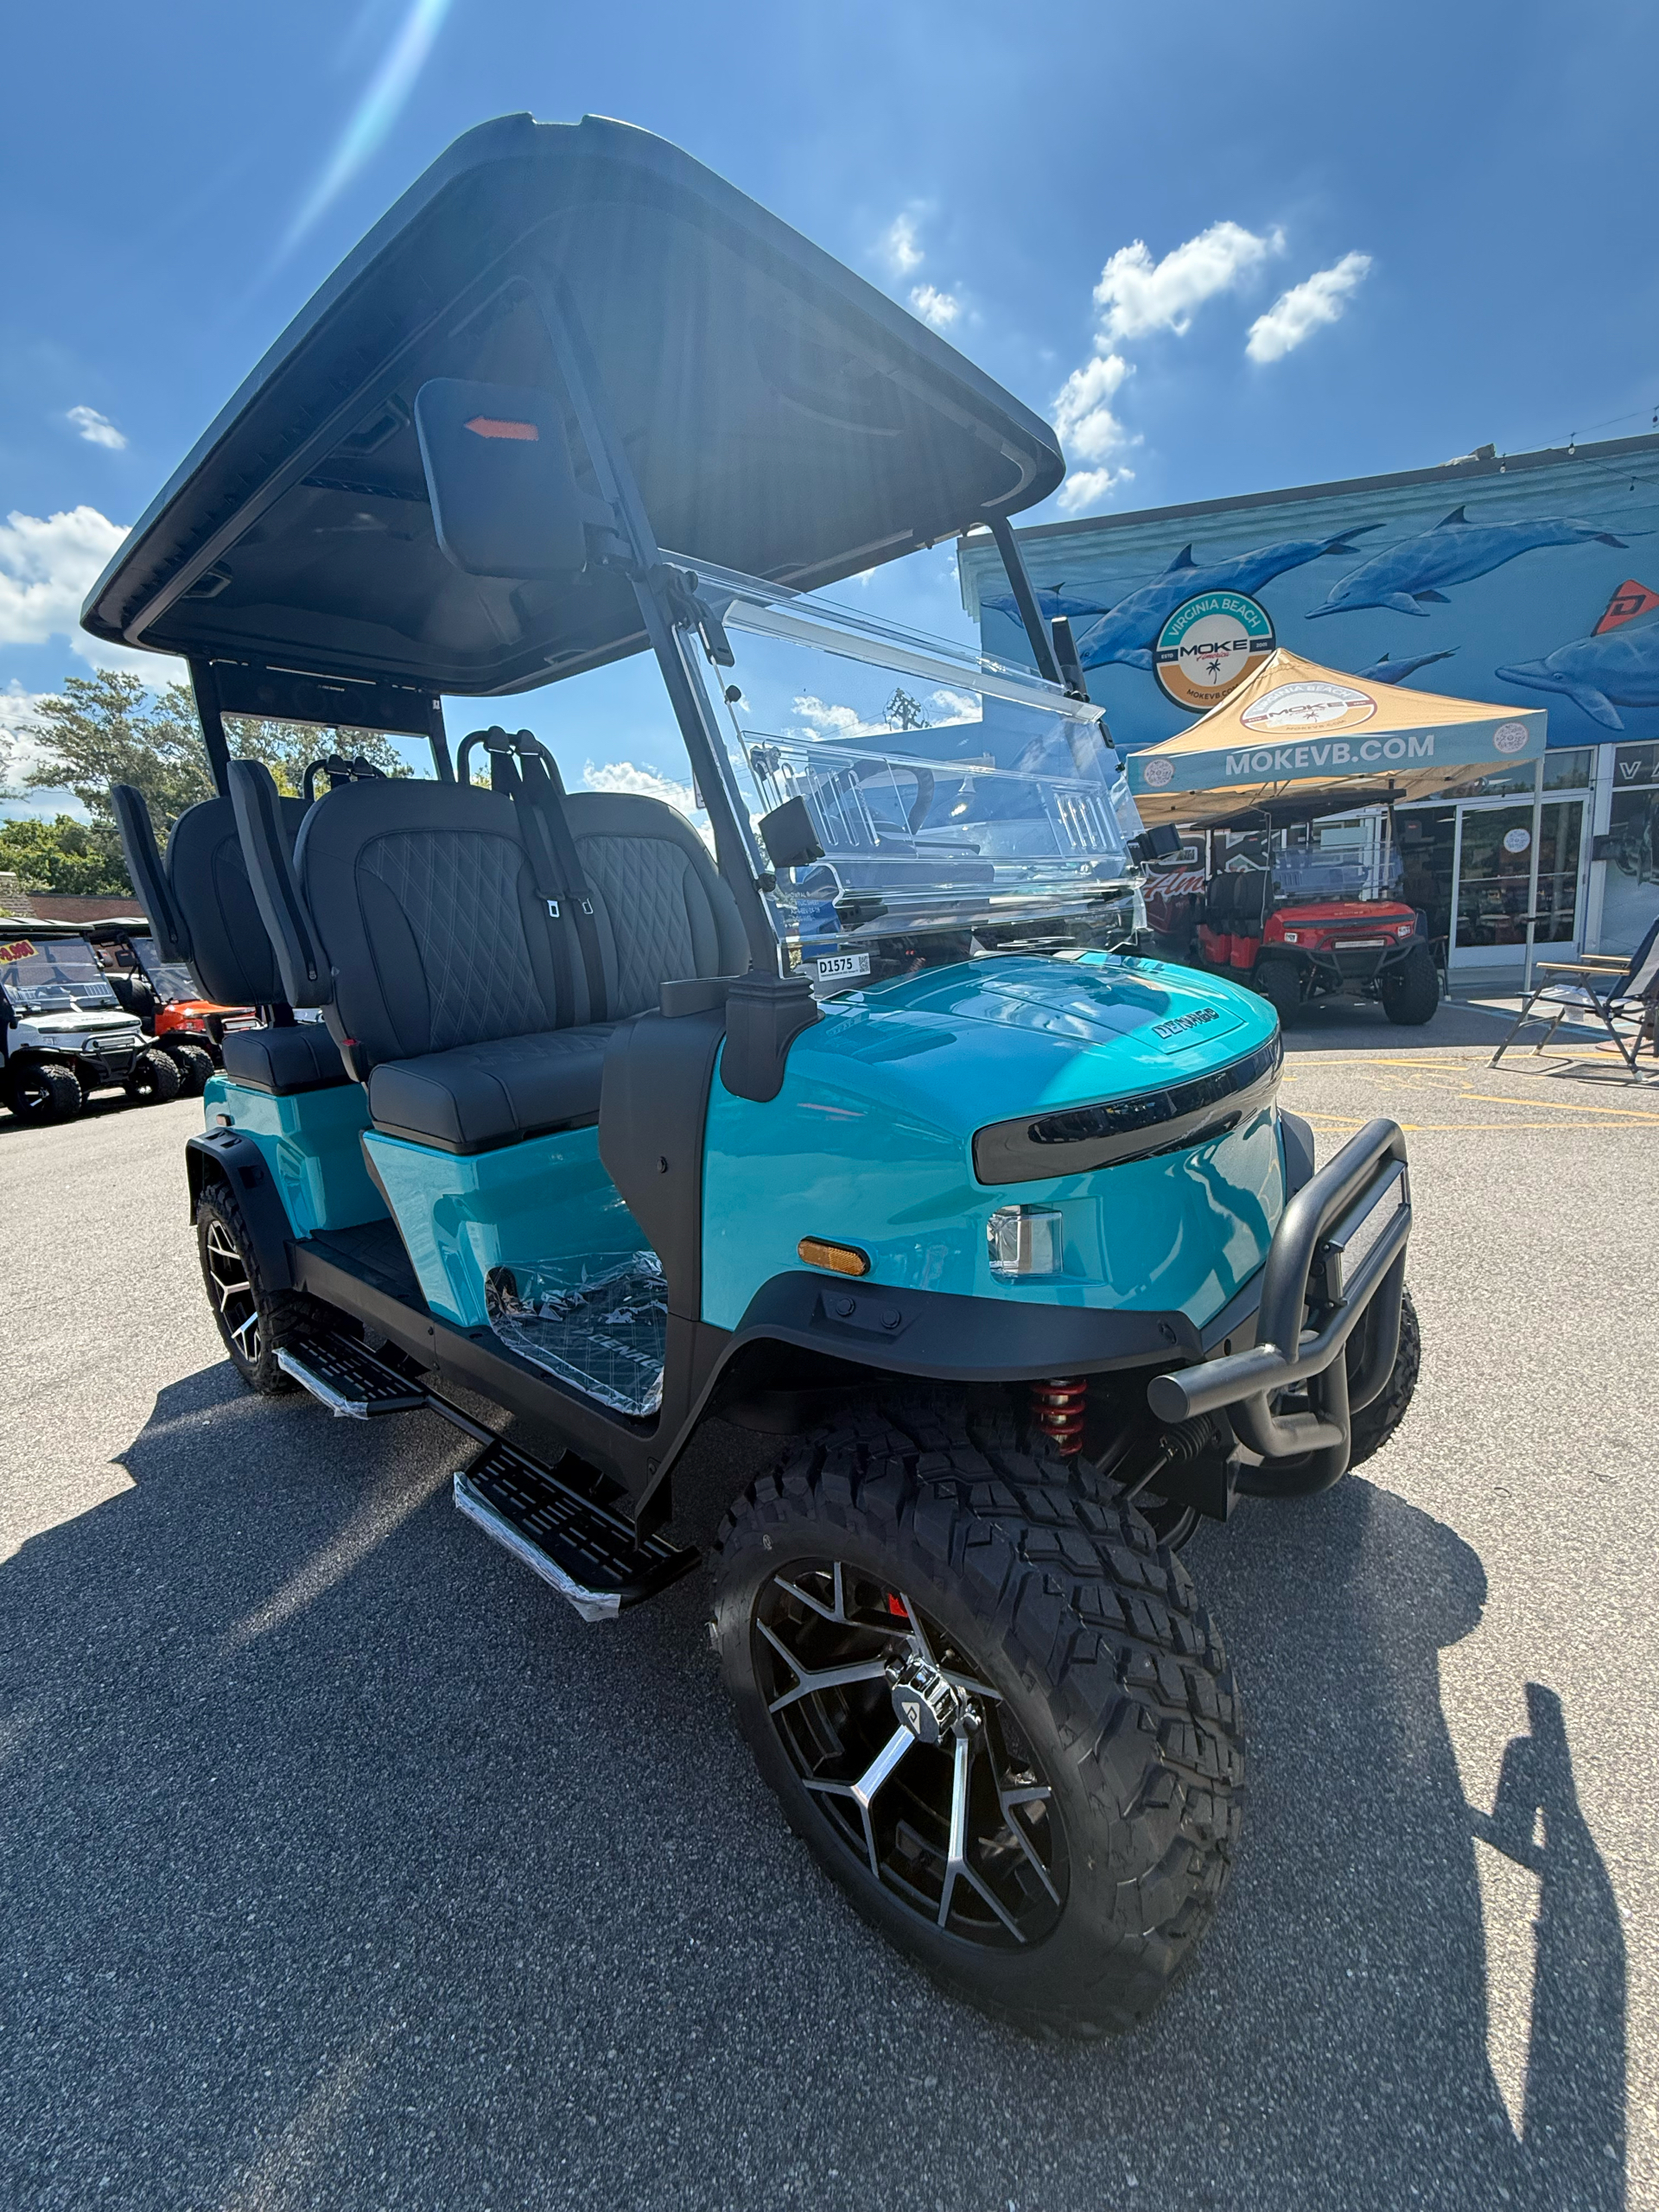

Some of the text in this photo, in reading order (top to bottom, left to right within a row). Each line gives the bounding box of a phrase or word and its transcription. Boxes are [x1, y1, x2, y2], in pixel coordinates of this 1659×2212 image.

[1168, 598, 1261, 636] VIRGINIA BEACH
[1180, 639, 1247, 657] MOKE
[1252, 684, 1351, 712] VIRGINIA BEACH
[1268, 702, 1344, 717] MOKE
[1225, 734, 1435, 776] MOKEVB.COM
[819, 958, 853, 973] D1575
